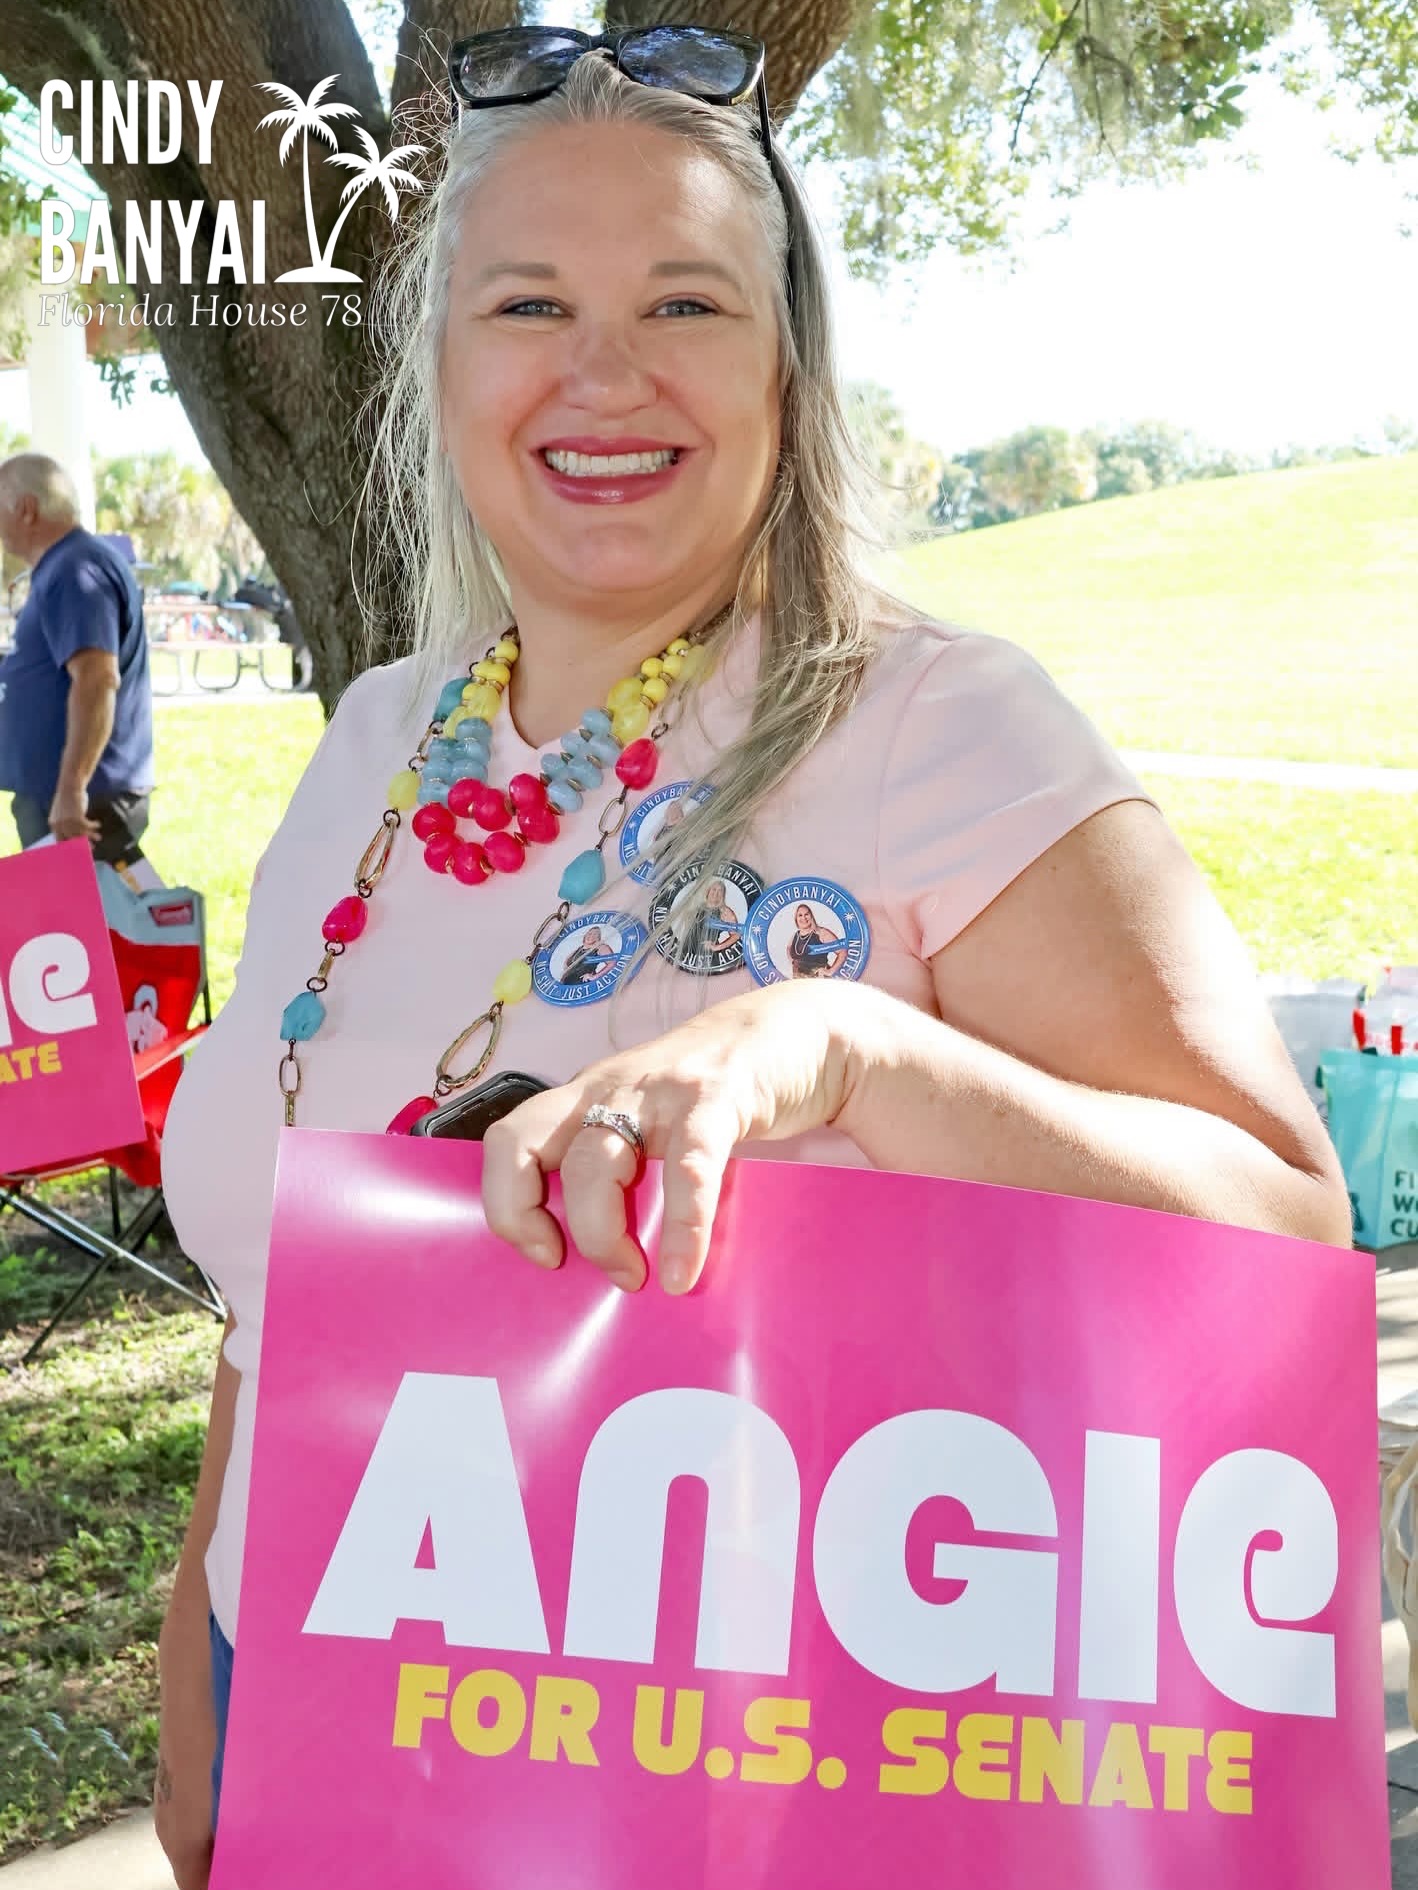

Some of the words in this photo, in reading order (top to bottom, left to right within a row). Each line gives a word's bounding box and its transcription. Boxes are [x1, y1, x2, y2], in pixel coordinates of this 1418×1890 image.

[758, 886, 842, 921] CINDYBANYAI
[562, 985, 590, 1000] JUST
[302, 1371, 1338, 1718] ANGIE
[393, 1663, 599, 1765] FOR
[633, 1686, 846, 1788] U.S.
[879, 1708, 1252, 1814] SENATE
